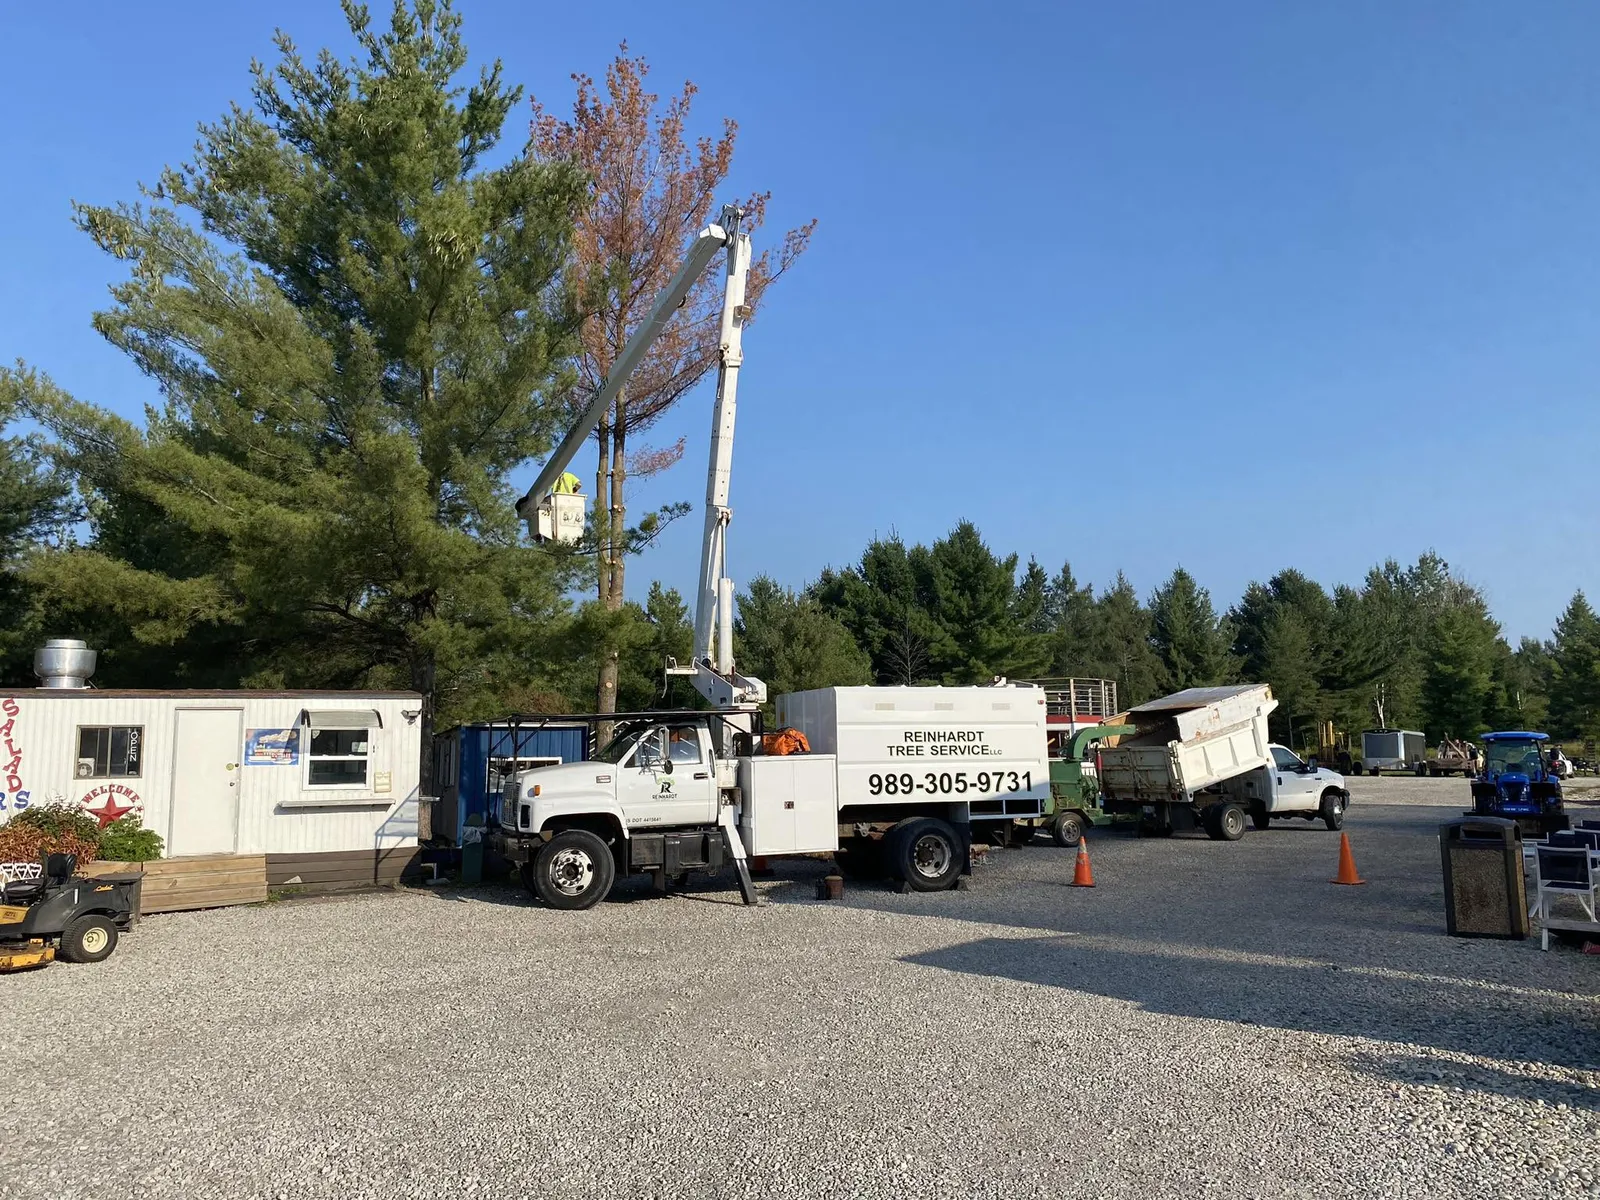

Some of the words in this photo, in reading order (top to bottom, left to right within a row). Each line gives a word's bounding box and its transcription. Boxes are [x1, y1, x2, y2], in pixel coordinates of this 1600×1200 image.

[130, 731, 139, 762] OPEN
[904, 731, 984, 743] REINHARDT
[887, 745, 925, 756] TREE
[868, 771, 1032, 795] 989-305-9731
[82, 784, 140, 804] WELCOME
